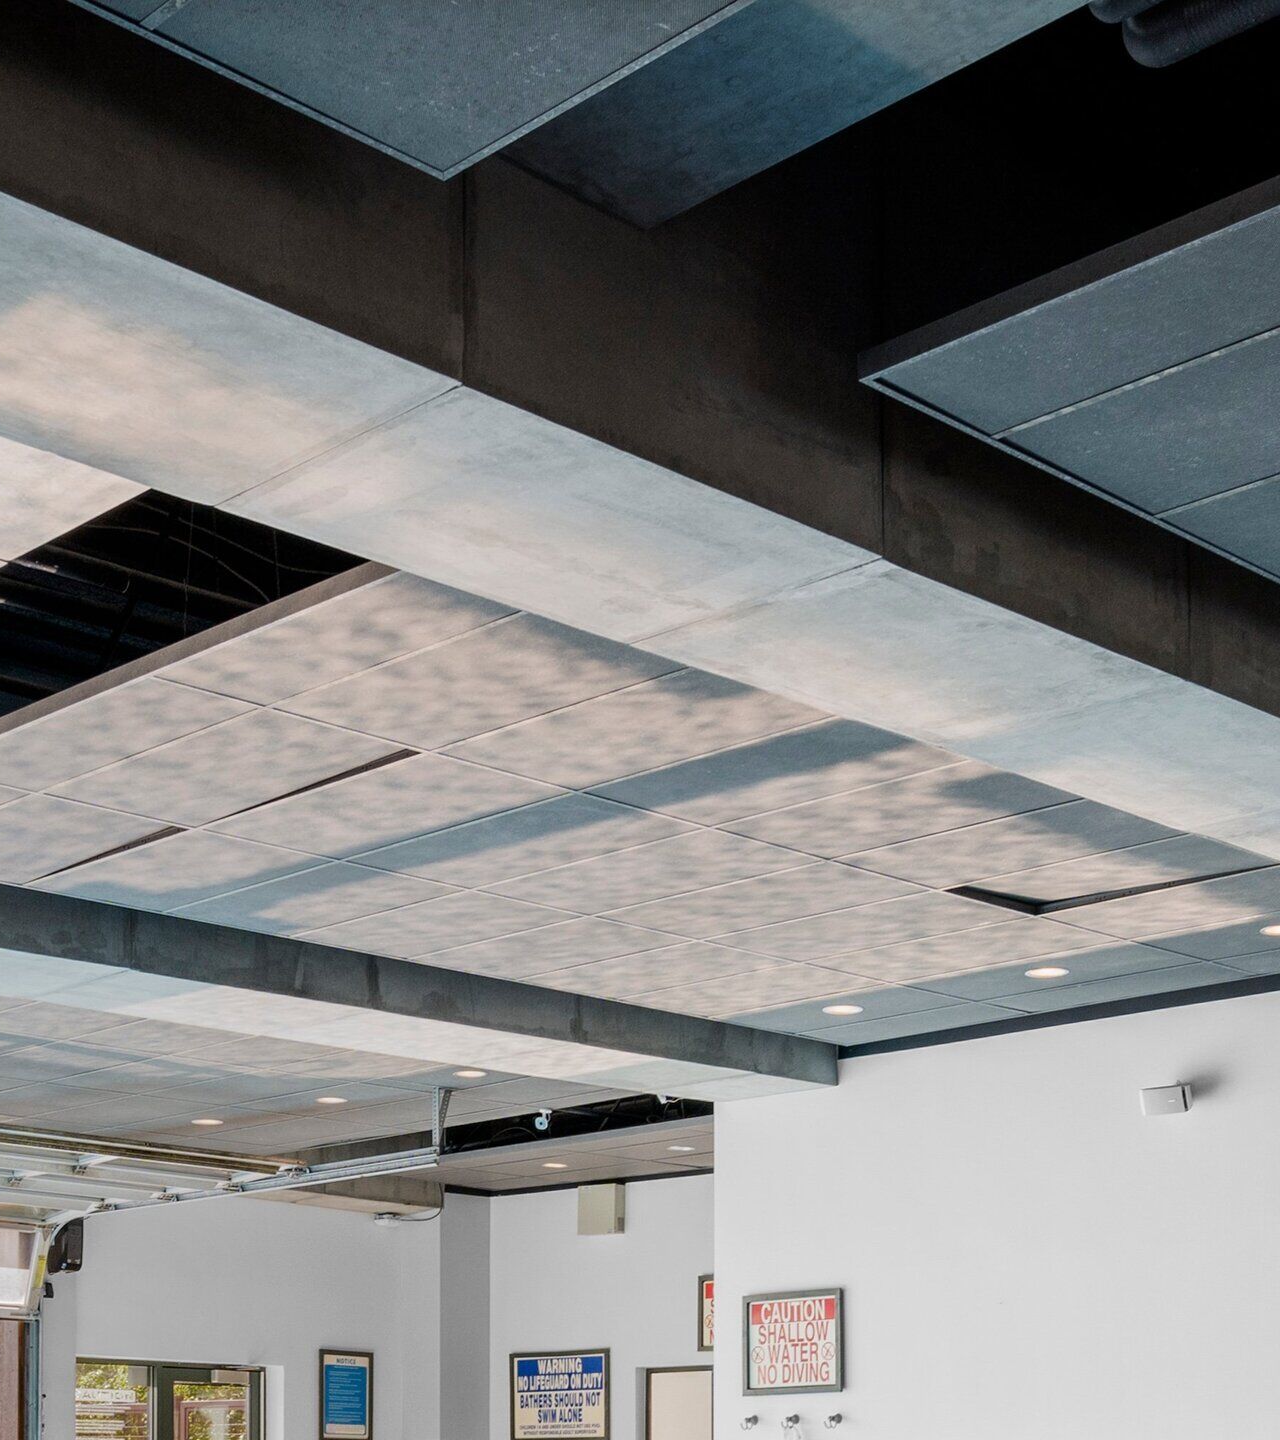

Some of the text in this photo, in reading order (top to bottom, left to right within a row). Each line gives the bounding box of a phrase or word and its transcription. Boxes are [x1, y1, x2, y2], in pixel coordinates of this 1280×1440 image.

[761, 1300, 825, 1324] CAUTION
[758, 1322, 829, 1345] SHALLOW
[768, 1342, 819, 1364] WATER
[537, 1357, 582, 1374] WARNING
[757, 1362, 830, 1385] NO DIVING
[518, 1372, 602, 1391] NO LIFEGUARD ON DUTY
[520, 1392, 600, 1408] BATHERS SHOULD NOT
[537, 1408, 583, 1423] SWIM ALONE
